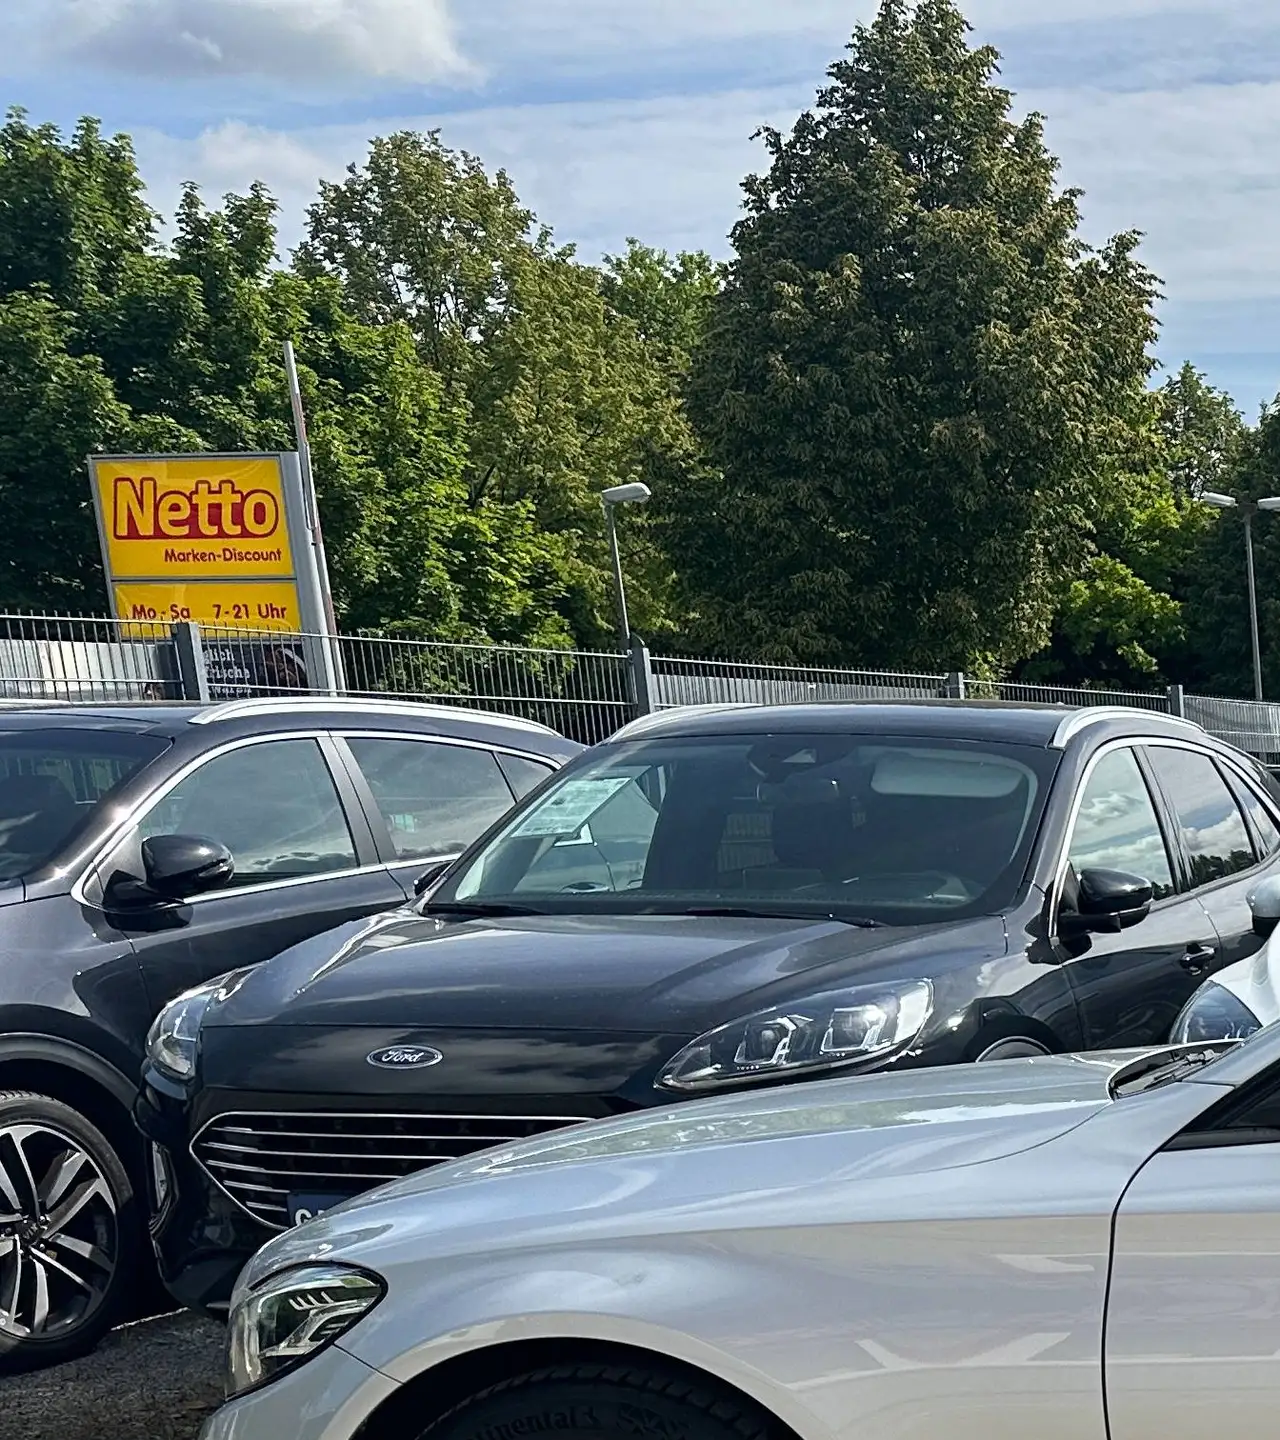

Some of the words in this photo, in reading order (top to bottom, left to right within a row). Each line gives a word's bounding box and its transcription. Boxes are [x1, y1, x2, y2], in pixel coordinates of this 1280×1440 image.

[113, 477, 279, 540] Netto
[164, 547, 282, 563] Marken-Discount
[132, 604, 157, 619] Mo
[258, 603, 287, 619] Uhr
[381, 1049, 424, 1062] Ford
